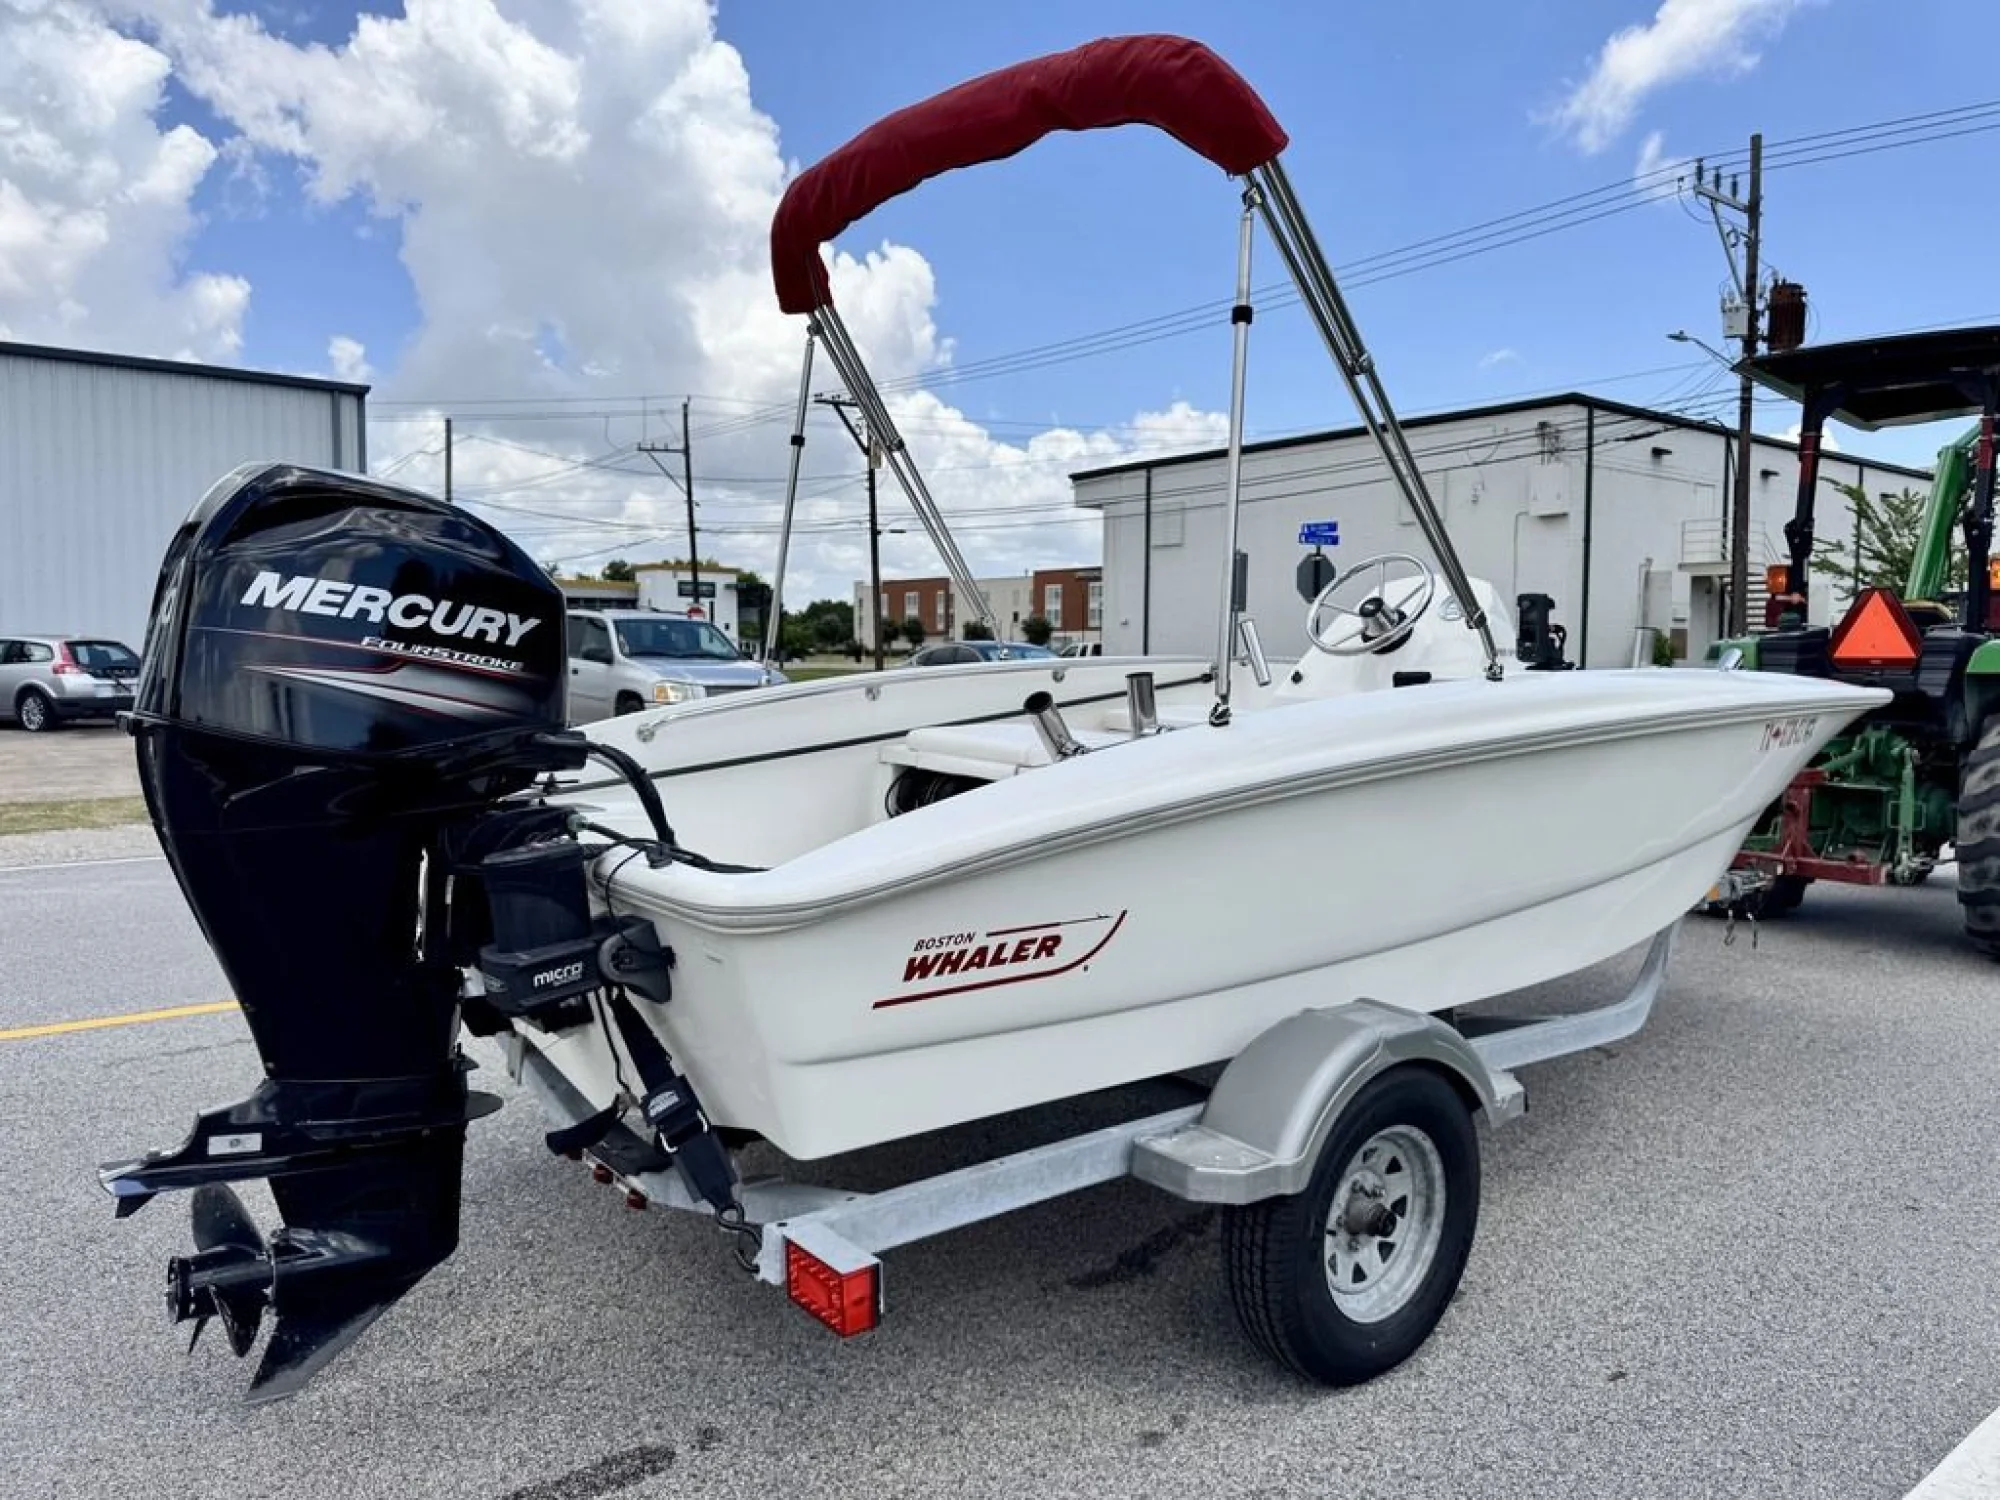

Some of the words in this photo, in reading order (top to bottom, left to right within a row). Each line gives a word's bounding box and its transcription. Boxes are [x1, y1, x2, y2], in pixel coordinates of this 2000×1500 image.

[240, 571, 541, 647] MERCURY
[360, 635, 525, 673] FOURSTROKE
[903, 935, 1062, 982] WHALER
[914, 933, 975, 951] BOSTON
